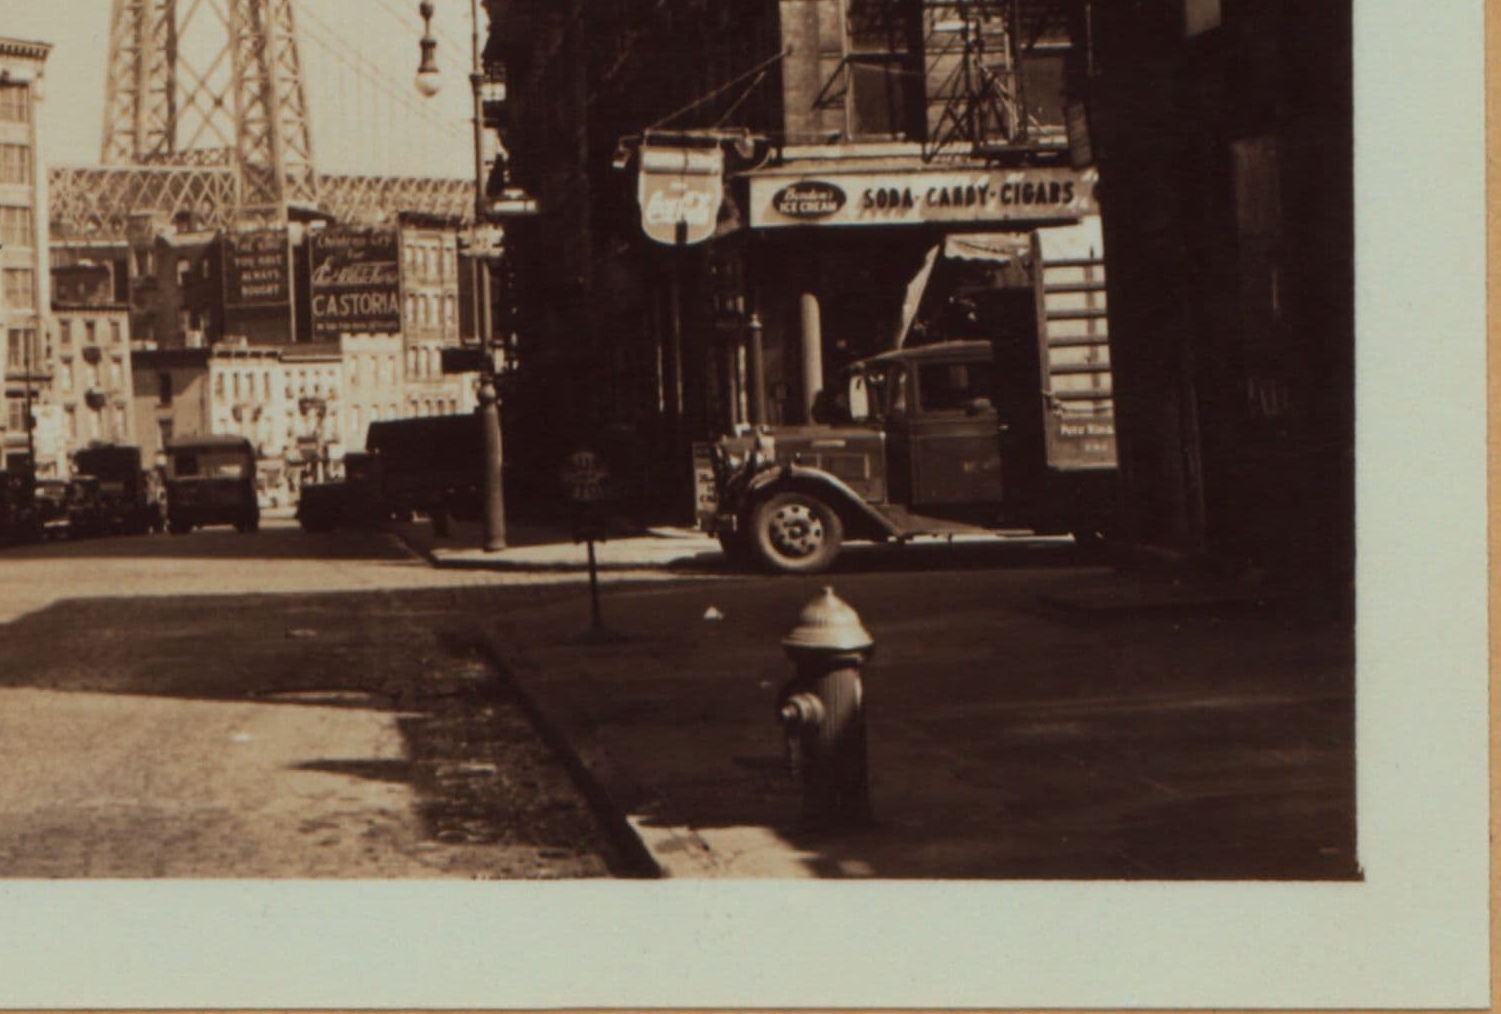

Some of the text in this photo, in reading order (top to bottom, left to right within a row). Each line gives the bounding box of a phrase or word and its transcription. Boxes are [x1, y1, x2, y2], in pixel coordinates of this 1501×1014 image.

[779, 201, 837, 213] ICE CREAM
[862, 181, 1075, 209] SODA CANDY CIGARS
[311, 292, 399, 317] CASTORIA
